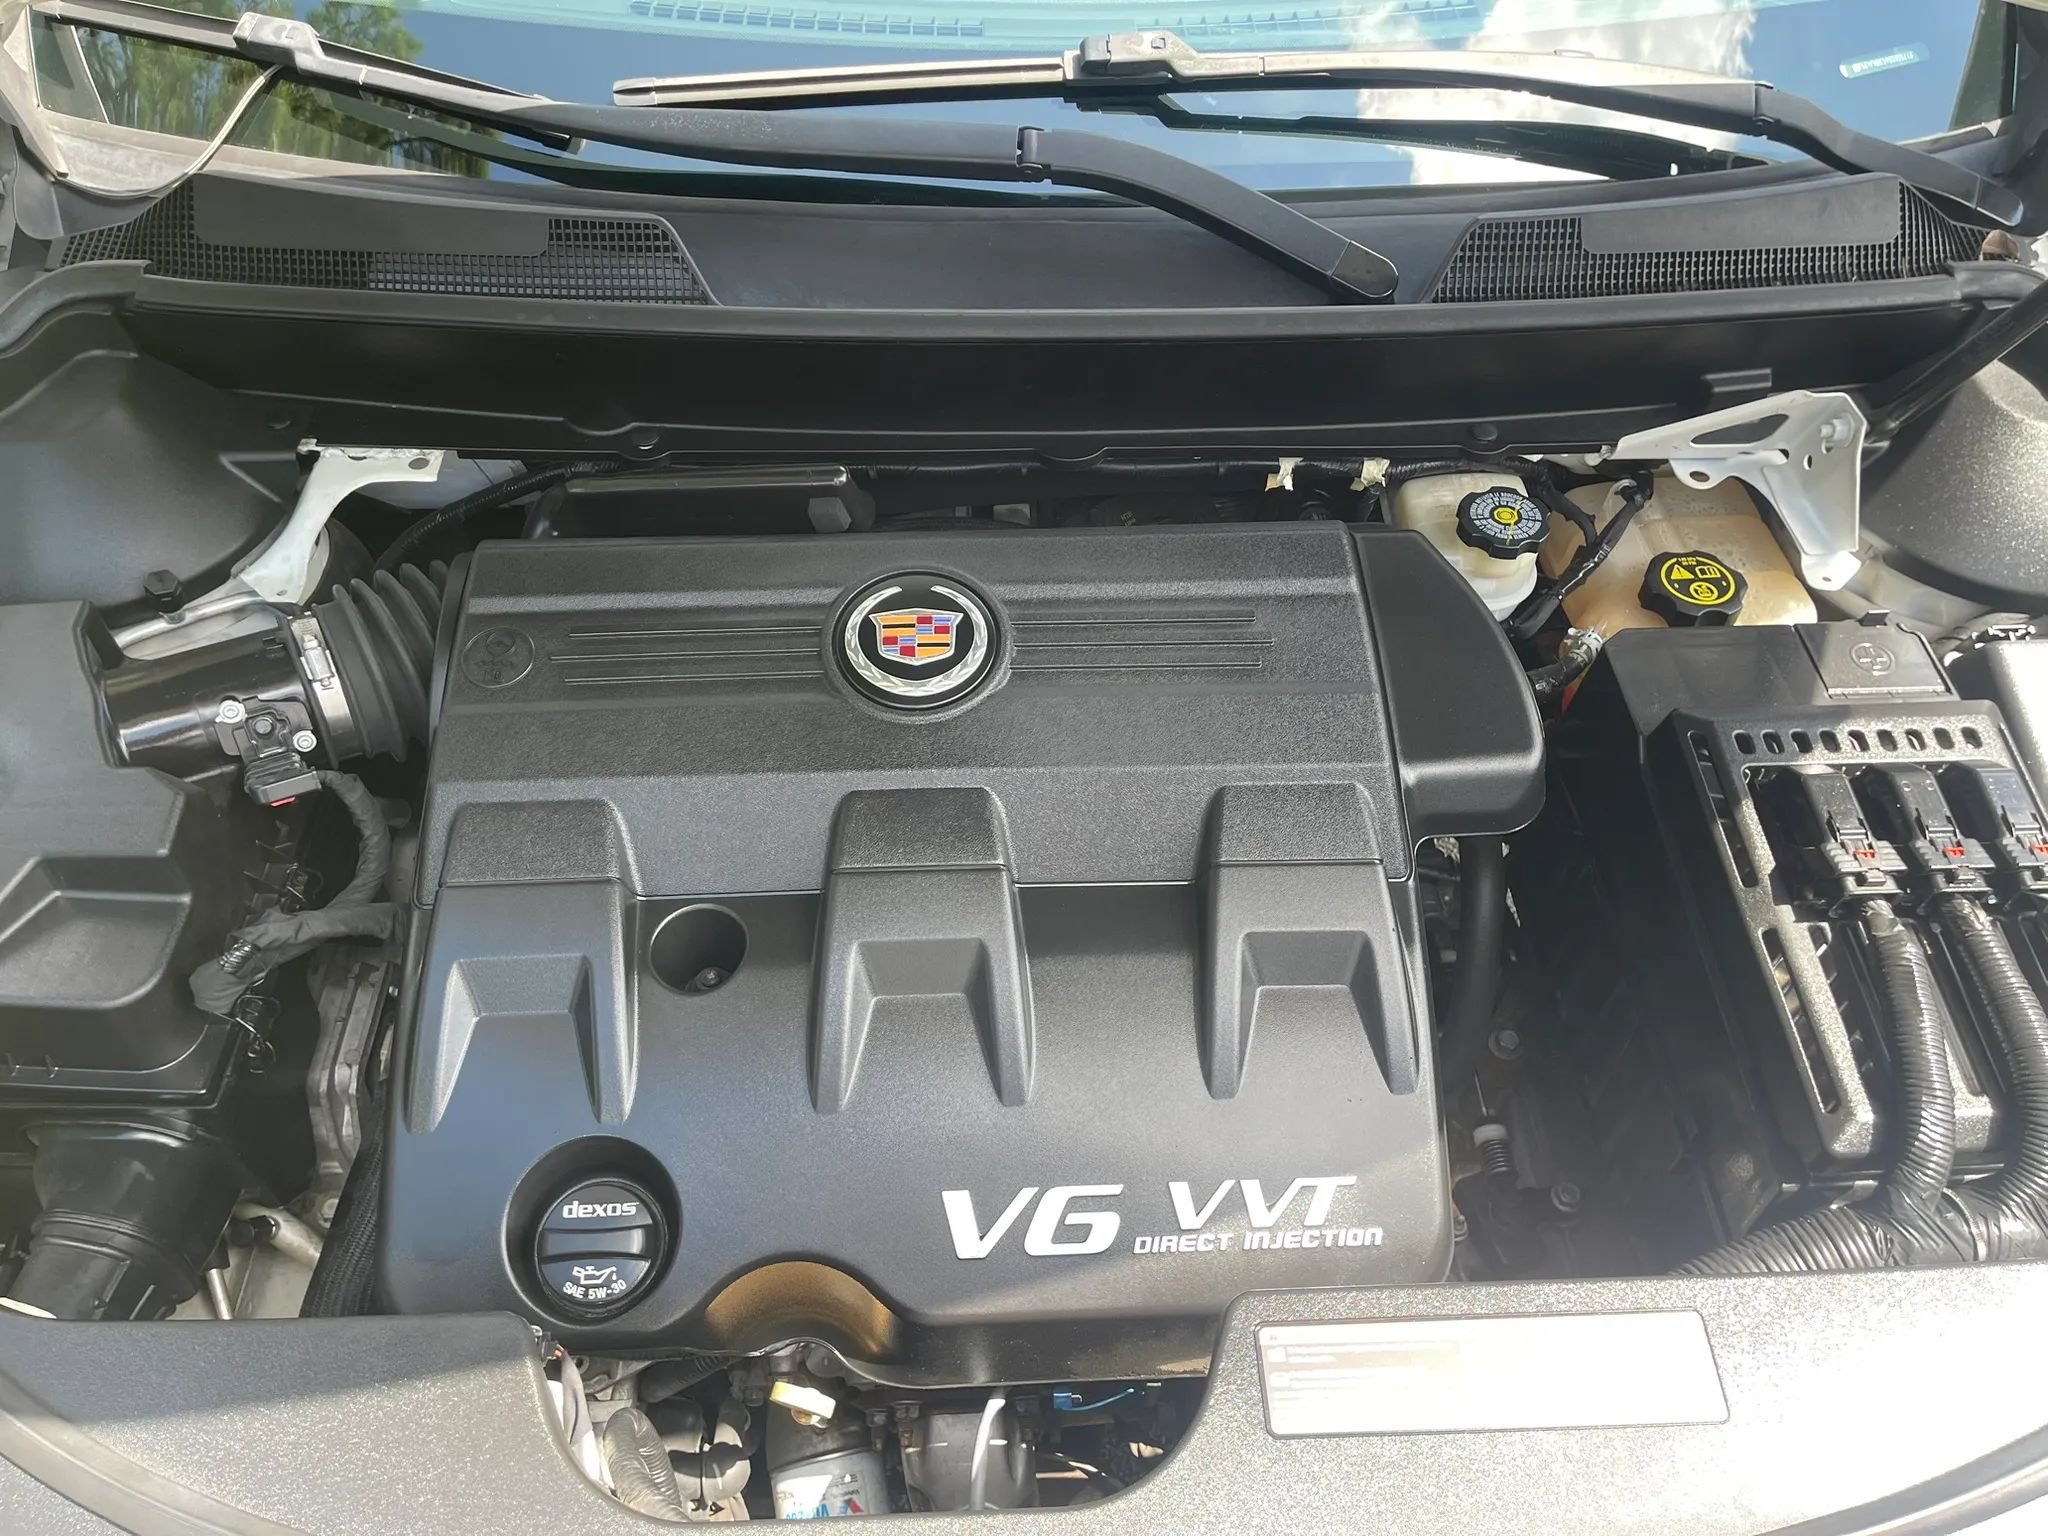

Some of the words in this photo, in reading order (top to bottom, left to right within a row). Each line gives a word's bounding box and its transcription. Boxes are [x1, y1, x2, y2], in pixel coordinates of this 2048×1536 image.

[562, 1200, 639, 1219] dexos
[942, 1184, 1125, 1260] V6
[1168, 1175, 1358, 1231] VVT
[1133, 1232, 1233, 1254] DIRECT
[563, 1281, 586, 1299] SAE
[588, 1279, 627, 1300] 5W-30
